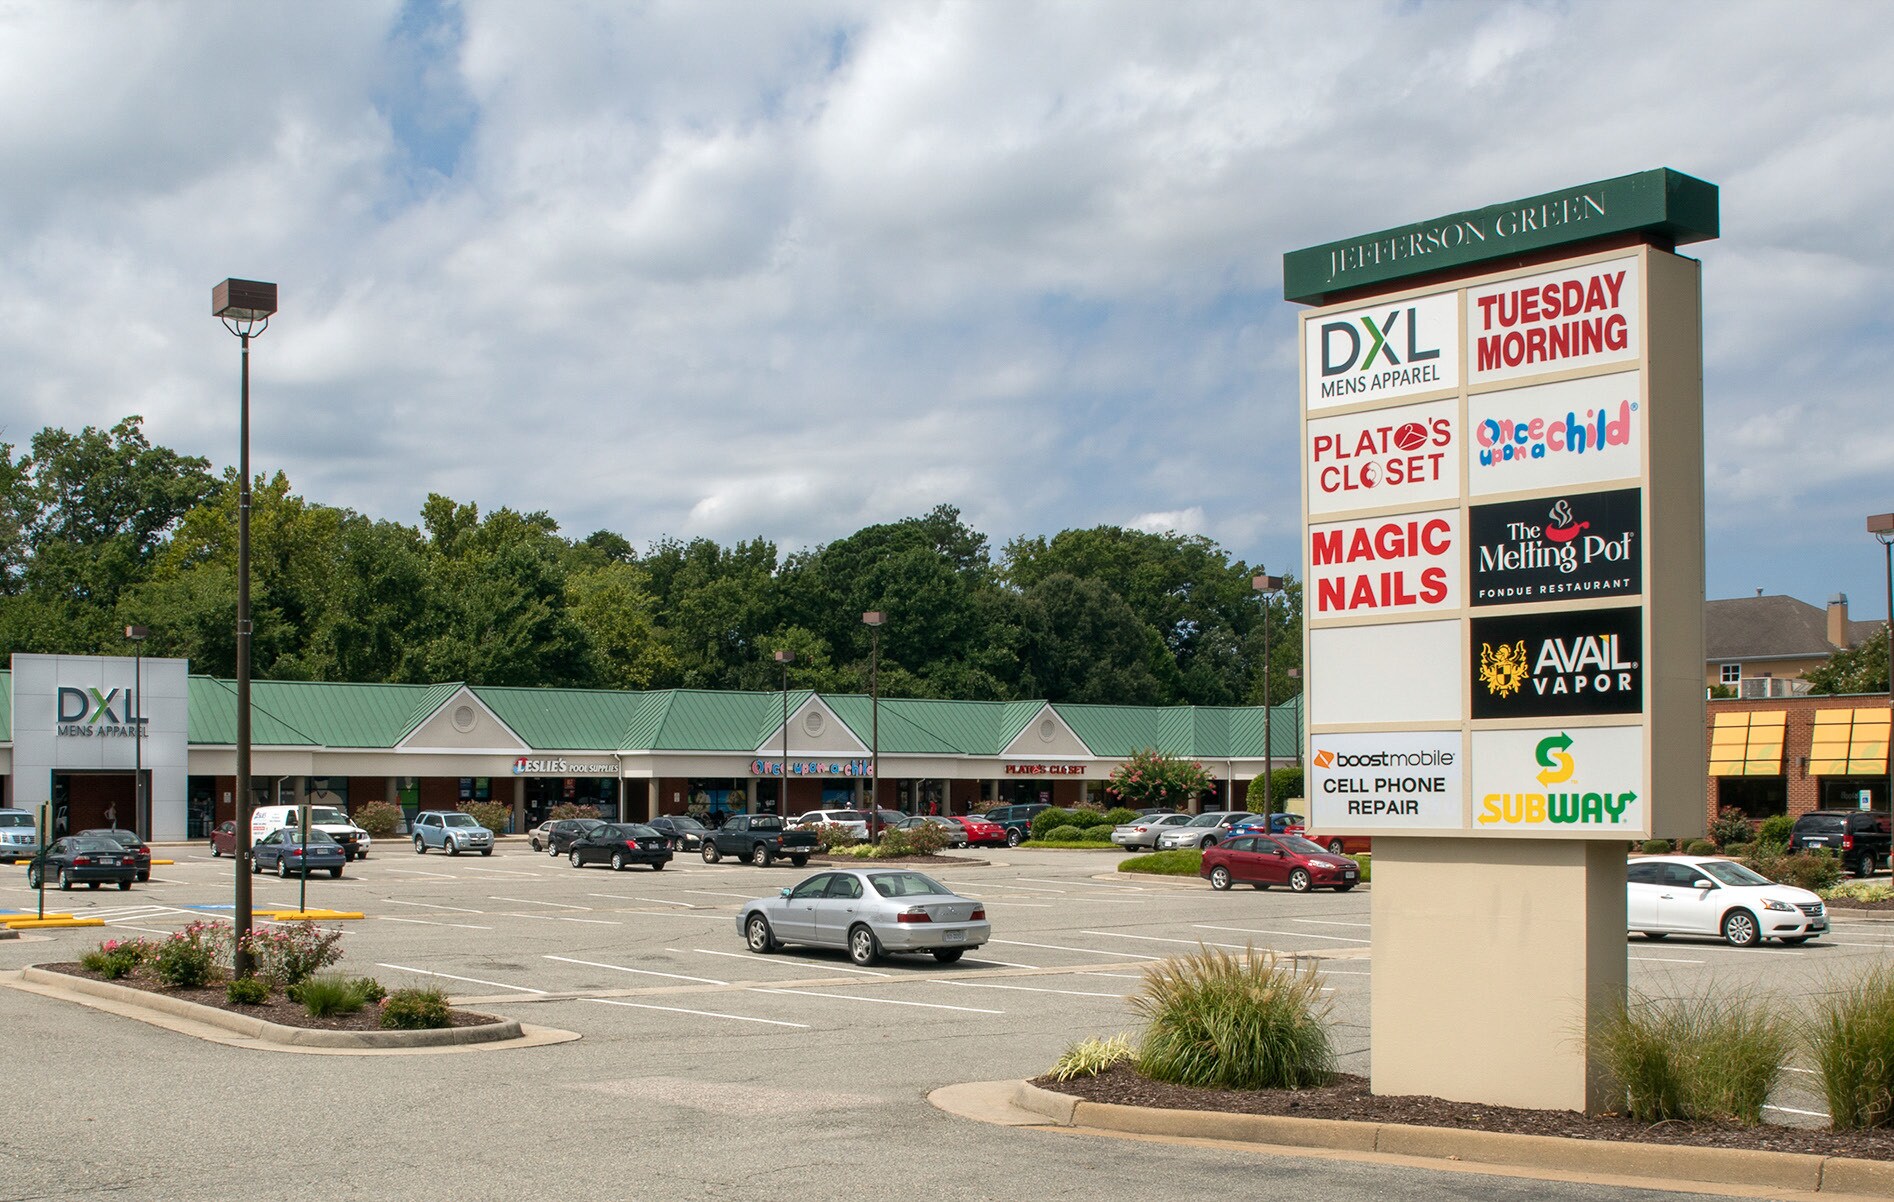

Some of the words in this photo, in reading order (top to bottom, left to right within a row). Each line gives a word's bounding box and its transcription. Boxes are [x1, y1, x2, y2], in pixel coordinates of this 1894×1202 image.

[1327, 219, 1486, 283] JEFFERSON
[1495, 191, 1606, 238] GREEN
[1478, 270, 1626, 331] TUESDAY
[1321, 307, 1440, 377] DXL
[1477, 313, 1628, 372] MORNING
[1321, 375, 1366, 399] MENS
[1371, 364, 1440, 391] APPAREL
[1313, 417, 1451, 462] PLATO'S
[1476, 417, 1545, 447] Once
[1546, 400, 1630, 455] child
[1479, 441, 1527, 467] upon
[1531, 443, 1545, 459] a
[1320, 453, 1445, 493] CLOSET
[1312, 519, 1451, 566] MAGIC
[1507, 522, 1540, 541] The
[1479, 539, 1578, 574] Melting
[1583, 532, 1631, 565] Pot
[1318, 567, 1448, 612] NAILS
[1479, 586, 1532, 598] FONDUE
[1540, 578, 1631, 594] RESTAURANT
[1533, 634, 1631, 675] AVAIL
[1533, 674, 1632, 695] VAPOR
[58, 687, 149, 723] DXL
[57, 725, 93, 737] MENS
[518, 758, 567, 772] LESLIE'S
[569, 764, 588, 772] POOL
[589, 764, 618, 772] SUPPLIES
[793, 762, 826, 776] upon
[829, 763, 839, 774] a
[1005, 764, 1046, 774] PLATO'S
[1049, 765, 1087, 774] CLOSET
[1323, 778, 1373, 794] CELL
[1375, 777, 1446, 793] PHONE
[1348, 800, 1419, 815] REPAIR
[1477, 790, 1638, 826] SUBWAY
